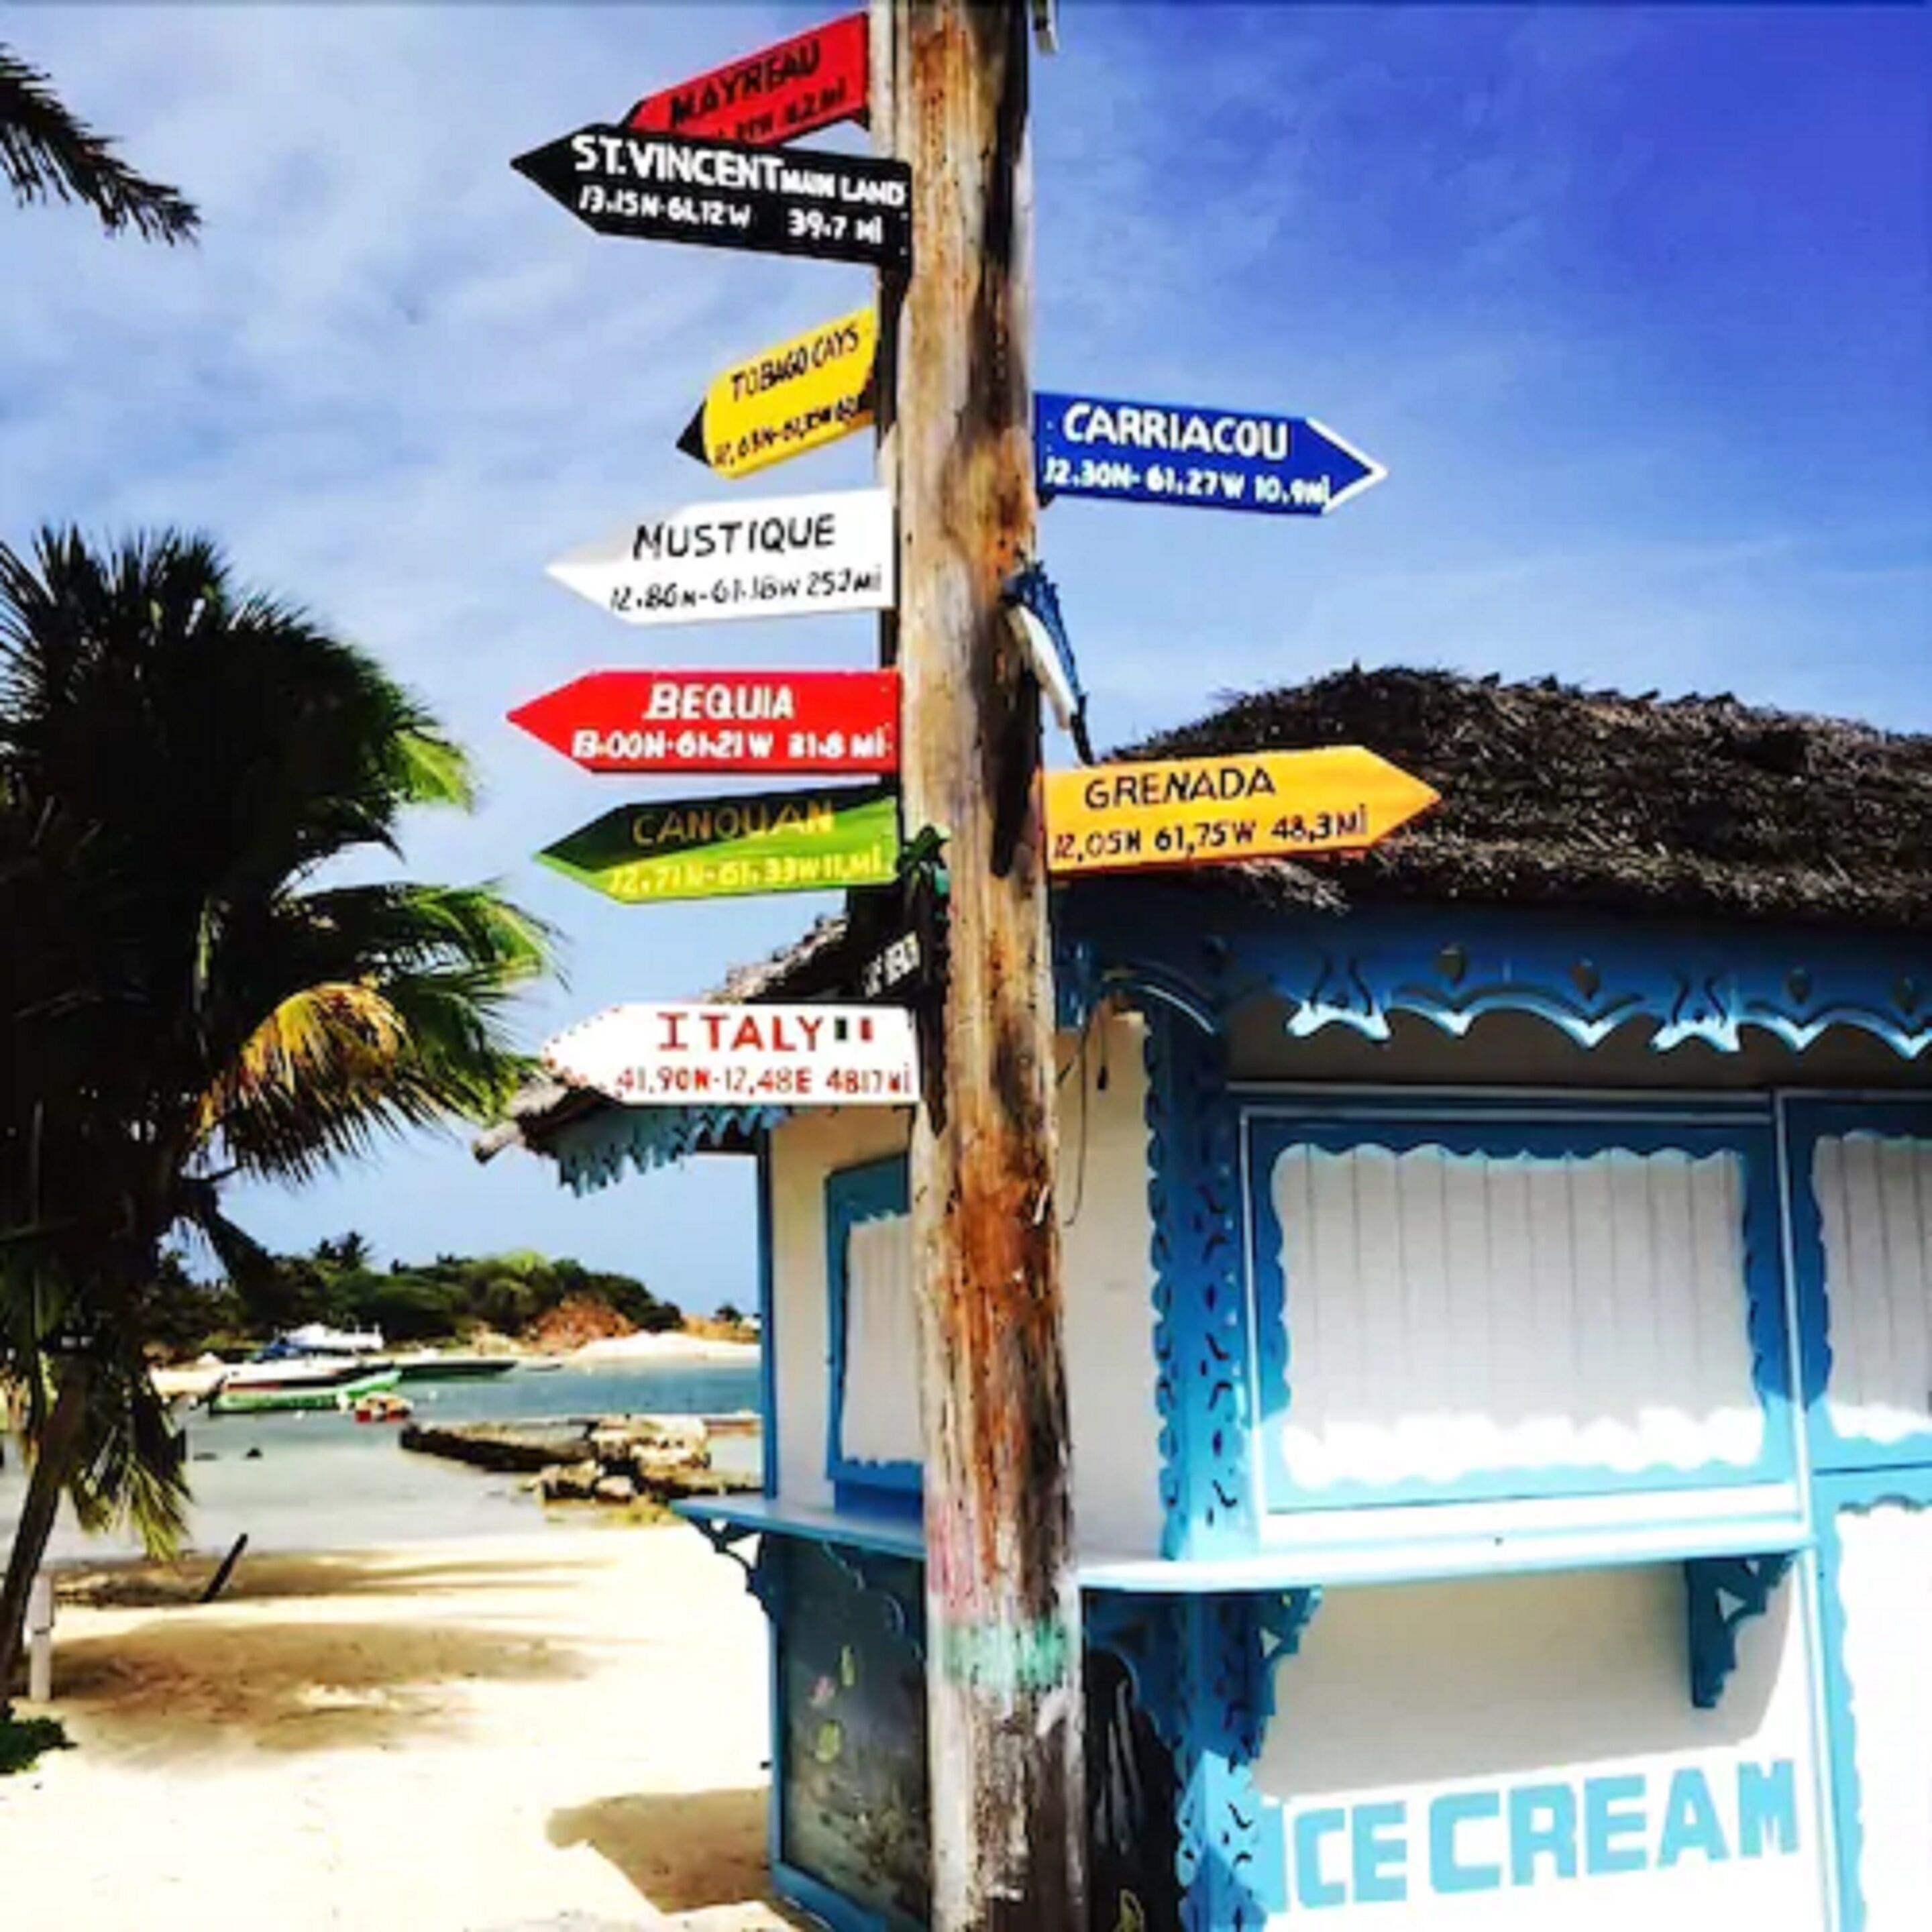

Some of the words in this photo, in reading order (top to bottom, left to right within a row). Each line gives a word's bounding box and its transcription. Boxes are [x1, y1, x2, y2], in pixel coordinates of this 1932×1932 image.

[840, 174, 906, 205] LAND
[810, 323, 859, 368] CAYS
[1063, 402, 1287, 460] CARRIACOU
[633, 514, 837, 561] MUSTIQUE
[641, 682, 796, 721] BEQUIA
[1083, 766, 1276, 808] GRENADA
[632, 800, 835, 847] CANOUAN
[657, 1012, 823, 1052] ITALY
[1263, 1799, 1407, 1915] ICE
[1428, 1758, 1800, 1894] CREAM
